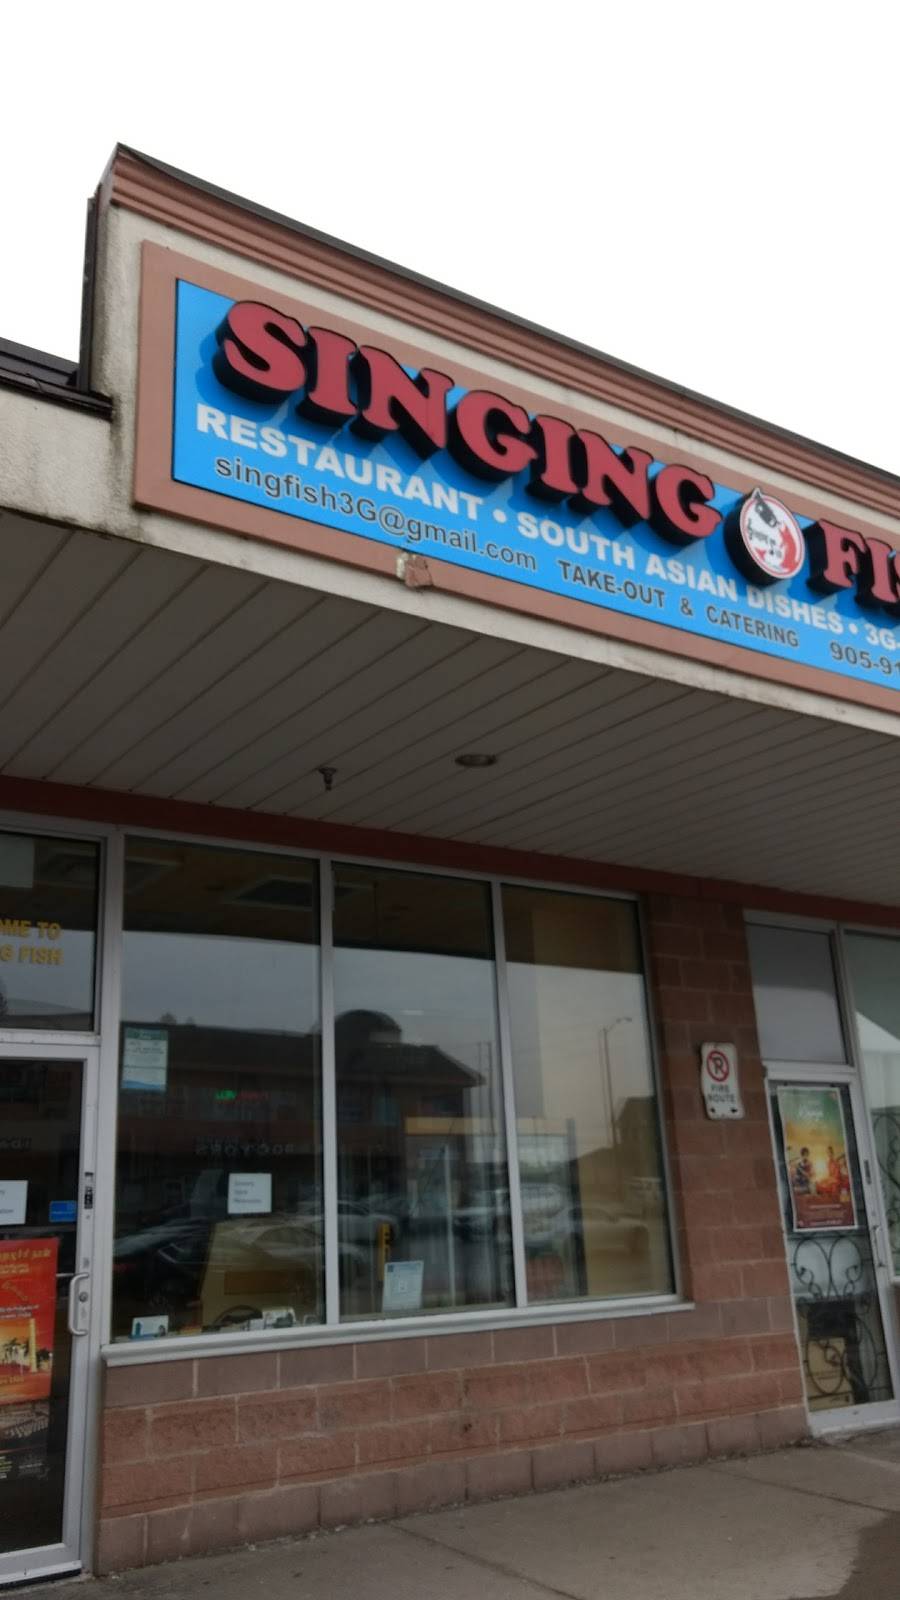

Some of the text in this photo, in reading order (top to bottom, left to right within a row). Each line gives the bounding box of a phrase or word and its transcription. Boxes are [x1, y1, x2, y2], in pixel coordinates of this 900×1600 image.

[196, 402, 484, 521] RESTAURANT
[517, 510, 634, 571] SOUTH
[645, 553, 738, 601] ASIAN
[746, 585, 844, 635] DISHES
[221, 300, 900, 603] SINGING FI
[215, 456, 537, 571] singfish3G@gmail.com
[558, 559, 667, 609] TAKE-OUT
[680, 598, 694, 617] &
[706, 606, 799, 648] CATERING
[19, 945, 63, 964] FISH
[36, 920, 62, 940] TO
